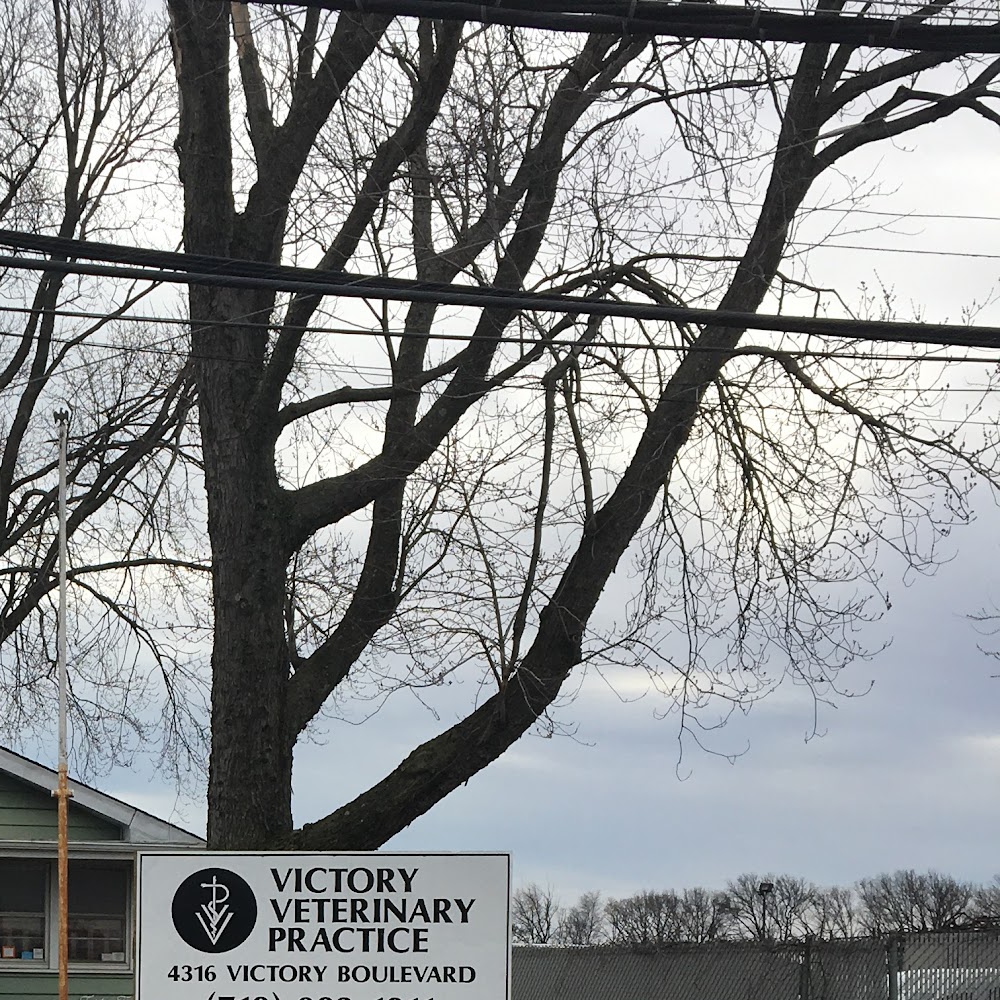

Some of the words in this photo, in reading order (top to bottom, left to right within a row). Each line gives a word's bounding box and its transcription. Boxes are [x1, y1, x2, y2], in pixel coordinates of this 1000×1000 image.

[269, 867, 419, 894] VICTORY
[269, 898, 477, 924] VETERINARY
[268, 927, 429, 953] PRACTICE
[167, 964, 217, 982] 4316
[226, 965, 328, 983] VICTORY
[337, 965, 476, 984] BOULEVARD
